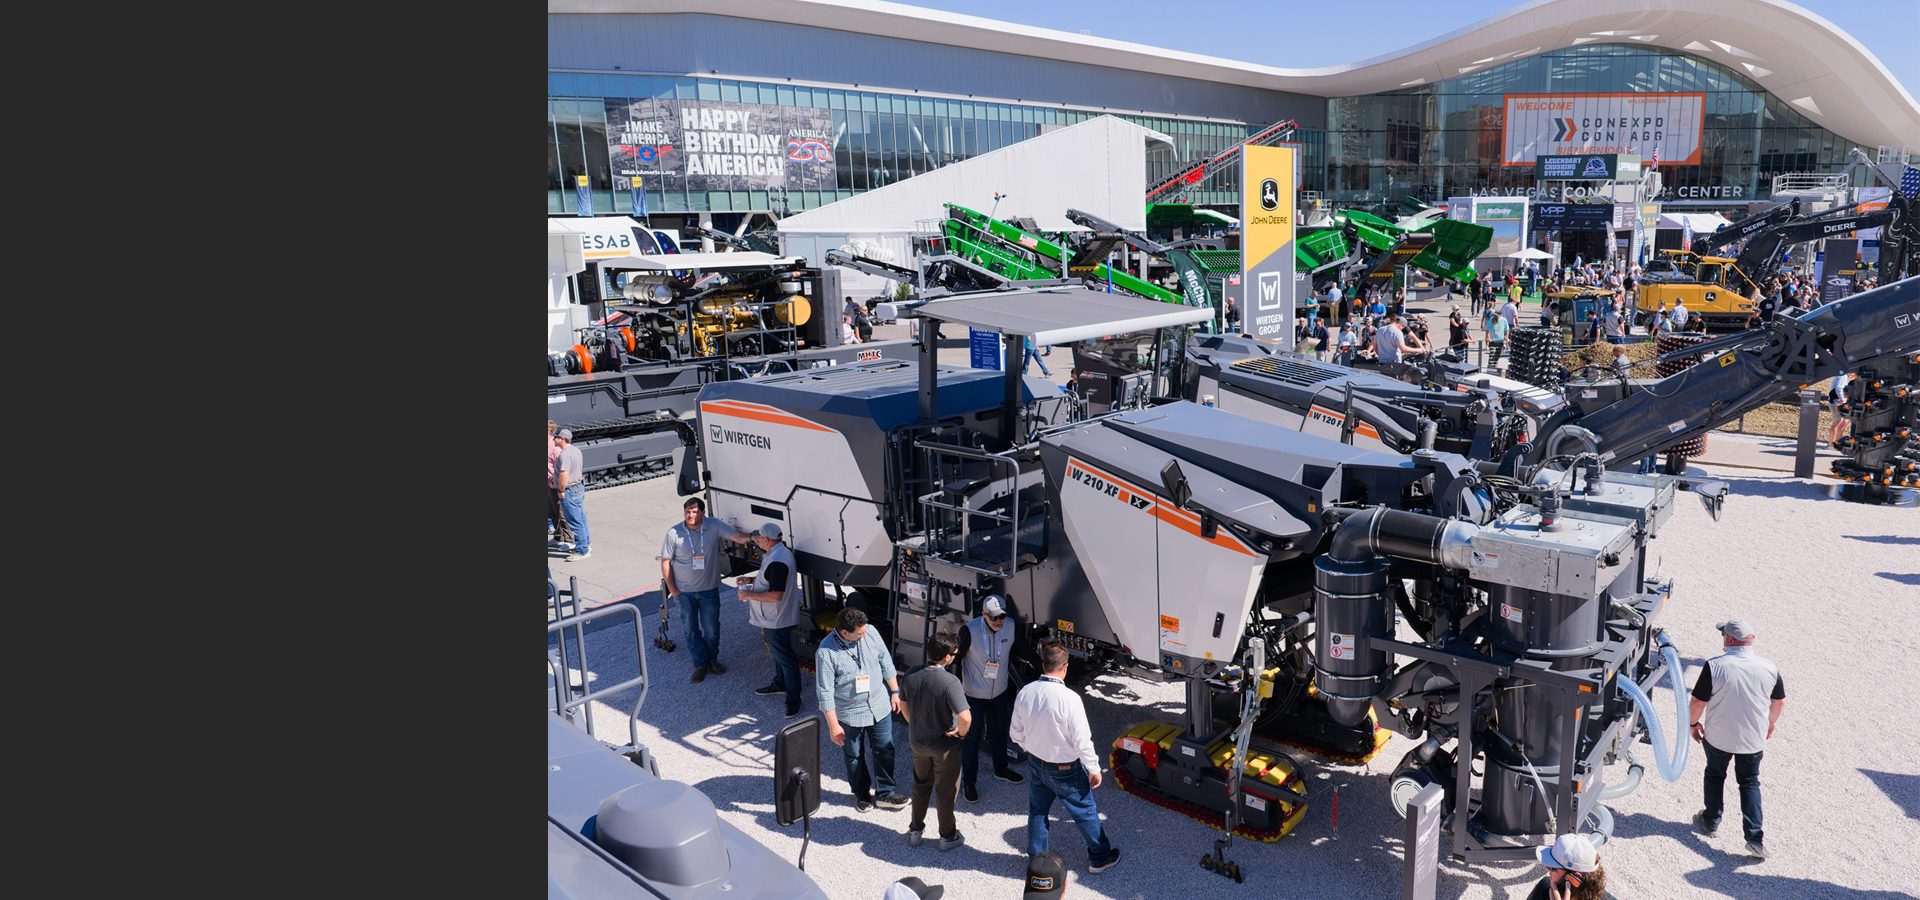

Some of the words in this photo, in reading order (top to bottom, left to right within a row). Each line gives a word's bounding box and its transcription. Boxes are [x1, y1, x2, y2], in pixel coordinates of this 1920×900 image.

[1516, 101, 1574, 111] WELCOME
[681, 107, 751, 132] HAPPY
[1582, 117, 1664, 128] CONEXPO
[631, 121, 663, 133] MAKE
[787, 129, 827, 139] AMERICA
[684, 131, 781, 155] BIRTHDAY
[1555, 146, 1632, 155] BIENVENIDOS
[686, 154, 784, 176] AMERICA!
[1504, 186, 1560, 198] VEGAS
[1678, 186, 1743, 197] CENTER
[1540, 206, 1566, 215] MPP
[1250, 215, 1268, 225] JOHN
[1268, 215, 1288, 225] DEERE
[1742, 219, 1767, 234] DEERE
[1824, 221, 1857, 233] DEERE
[583, 234, 631, 249] ESAB
[1256, 313, 1284, 326] WIRTGEN
[1258, 323, 1281, 336] GROUP
[1313, 411, 1321, 420] W
[1322, 415, 1336, 426] 120
[724, 429, 771, 450] WIRTGEN
[1072, 467, 1083, 481] W
[1083, 473, 1104, 491] 210
[1104, 483, 1119, 498] XF
